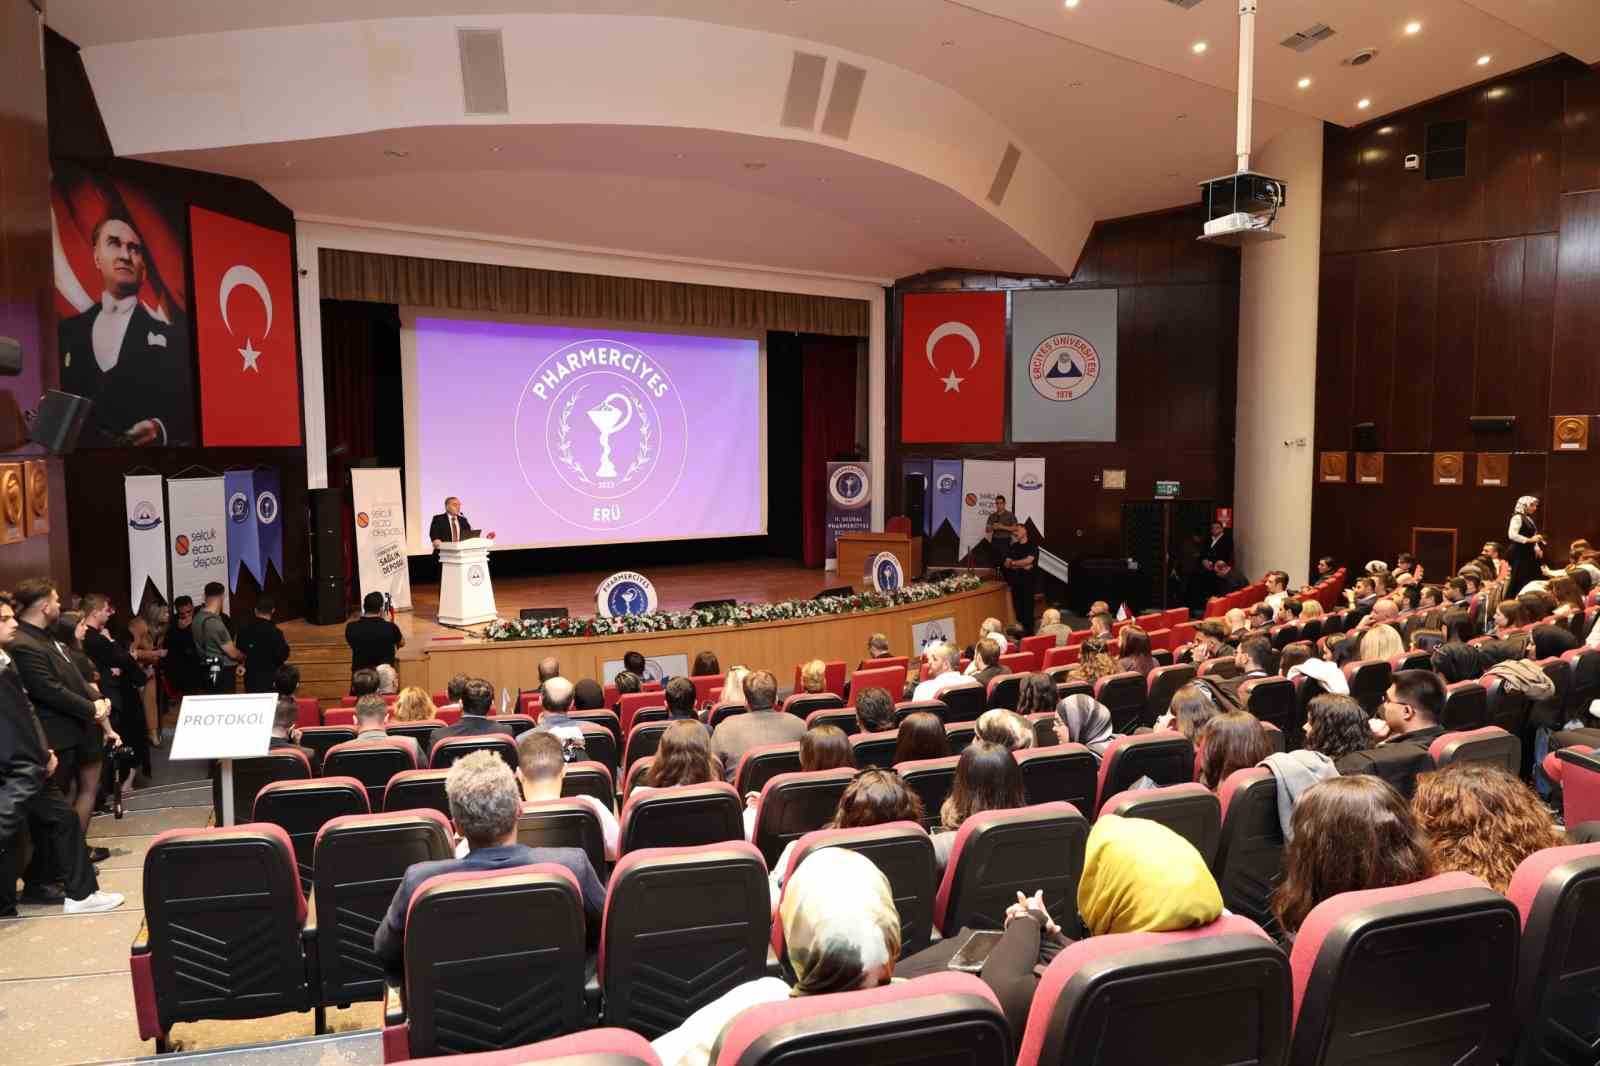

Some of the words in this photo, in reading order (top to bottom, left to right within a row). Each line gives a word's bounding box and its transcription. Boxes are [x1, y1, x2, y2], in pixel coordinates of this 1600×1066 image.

[532, 347, 669, 400] PHARMERCİYES
[593, 503, 621, 521] ERÜ
[191, 527, 217, 543] selçuk
[192, 543, 214, 556] ecza
[192, 555, 225, 569] deposu
[183, 713, 264, 726] PROTOKOL
